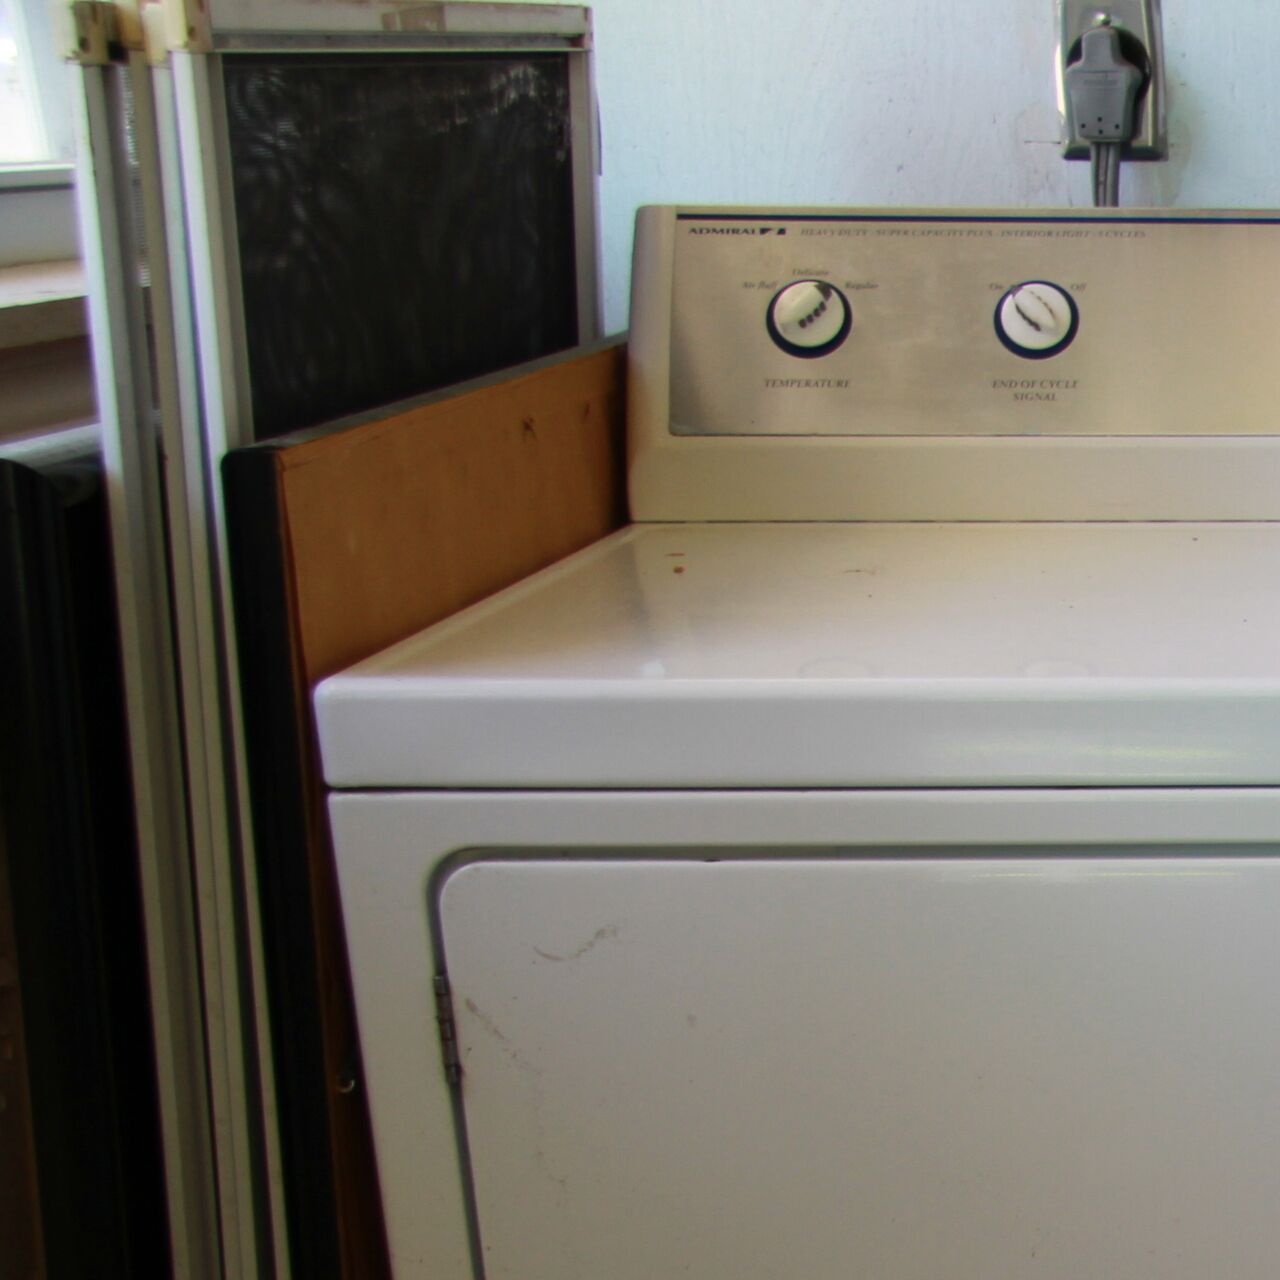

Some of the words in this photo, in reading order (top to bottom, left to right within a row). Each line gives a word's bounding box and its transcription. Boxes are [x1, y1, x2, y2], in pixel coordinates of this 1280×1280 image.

[688, 227, 757, 235] ADMIRAL
[800, 228, 836, 236] HEAVY
[838, 229, 868, 237] DUTY
[875, 229, 908, 237] SUPER
[911, 229, 965, 238] CAPACITY
[1001, 229, 1052, 238] INTERIOR
[1054, 230, 1090, 238] LIGHT
[1070, 282, 1087, 292] Off
[764, 379, 849, 389] TEMPERATURE
[992, 379, 1018, 389] END
[1020, 379, 1037, 389] OF
[1038, 379, 1079, 390] CYCLE
[1013, 391, 1058, 401] SIGNAL
